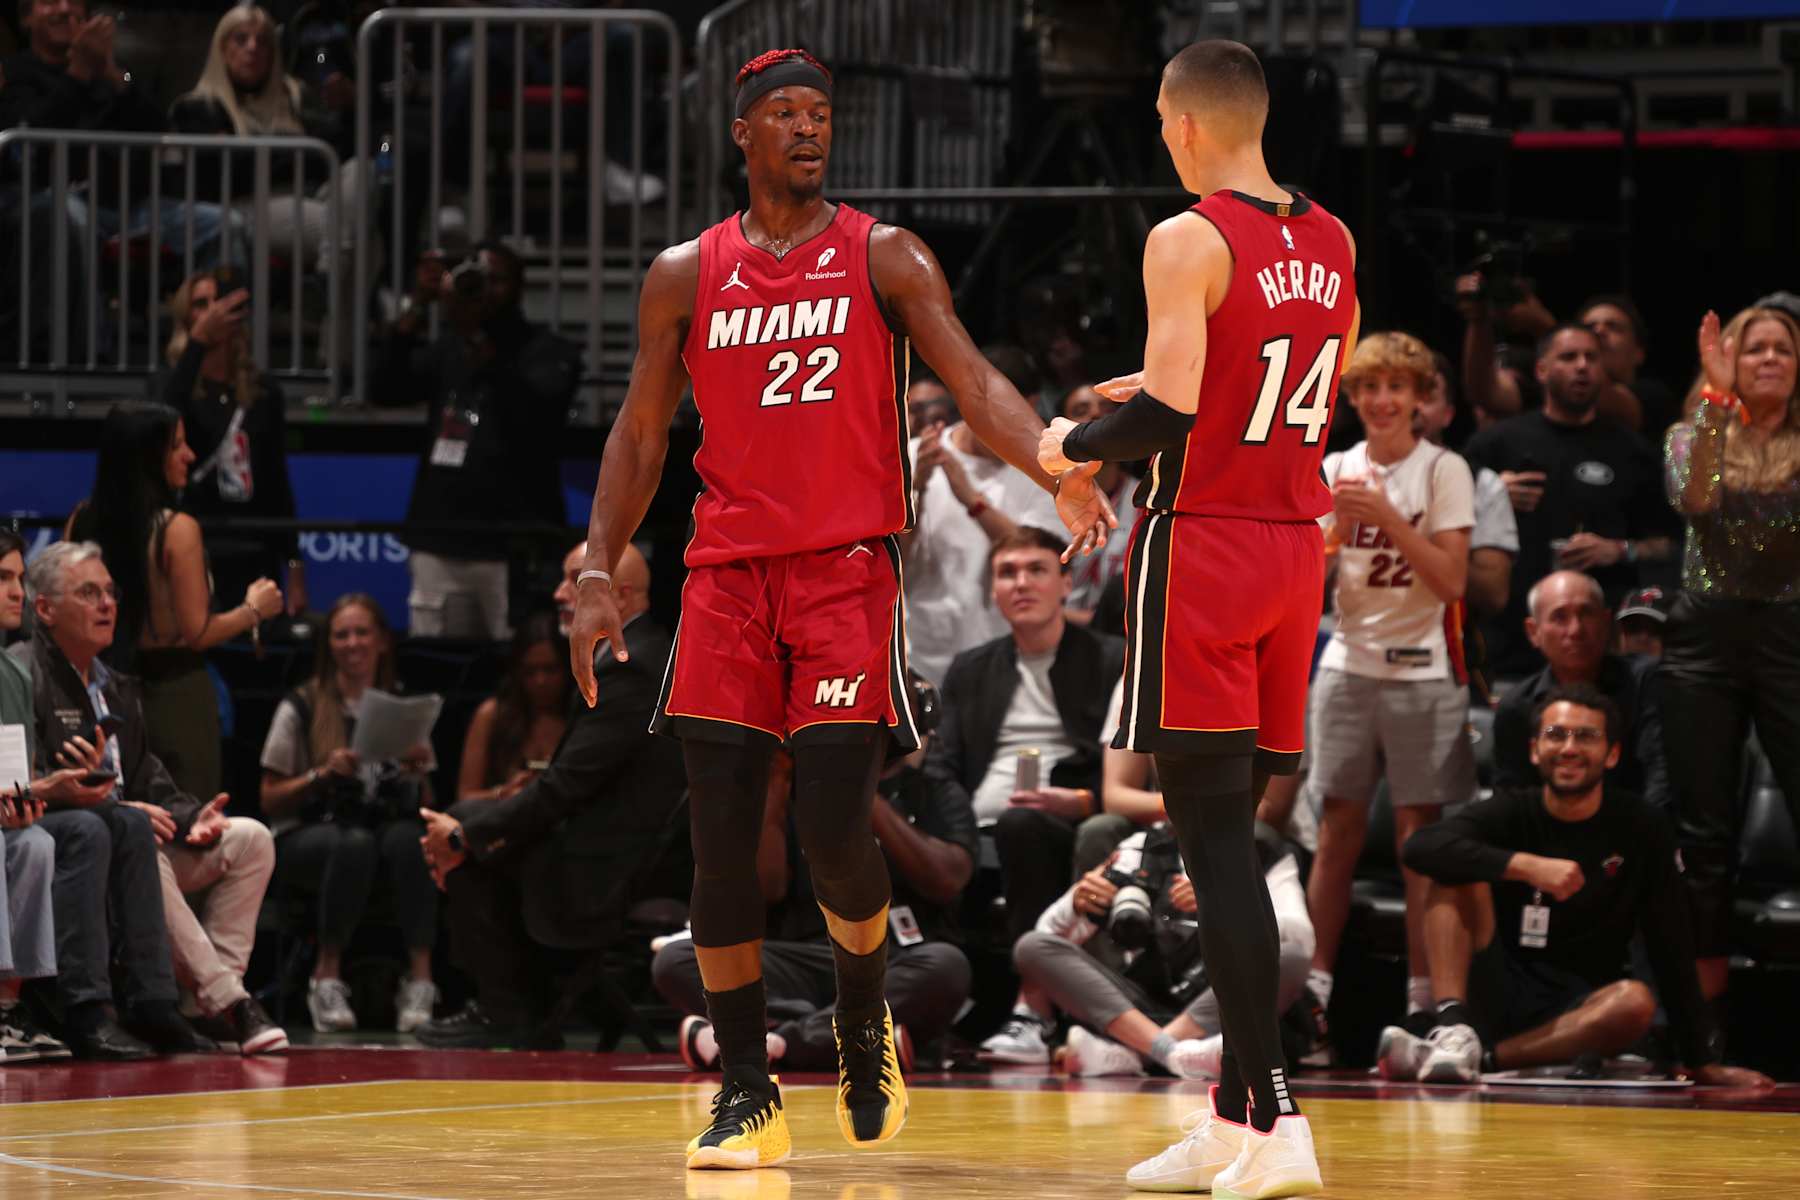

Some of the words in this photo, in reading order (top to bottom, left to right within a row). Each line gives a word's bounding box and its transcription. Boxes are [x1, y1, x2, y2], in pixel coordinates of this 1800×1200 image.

[805, 269, 846, 281] Robinhood
[1256, 259, 1342, 310] HERRO
[707, 296, 851, 350] MIAMI
[760, 345, 840, 408] 22
[1242, 335, 1342, 445] 14
[1367, 553, 1413, 588] 22
